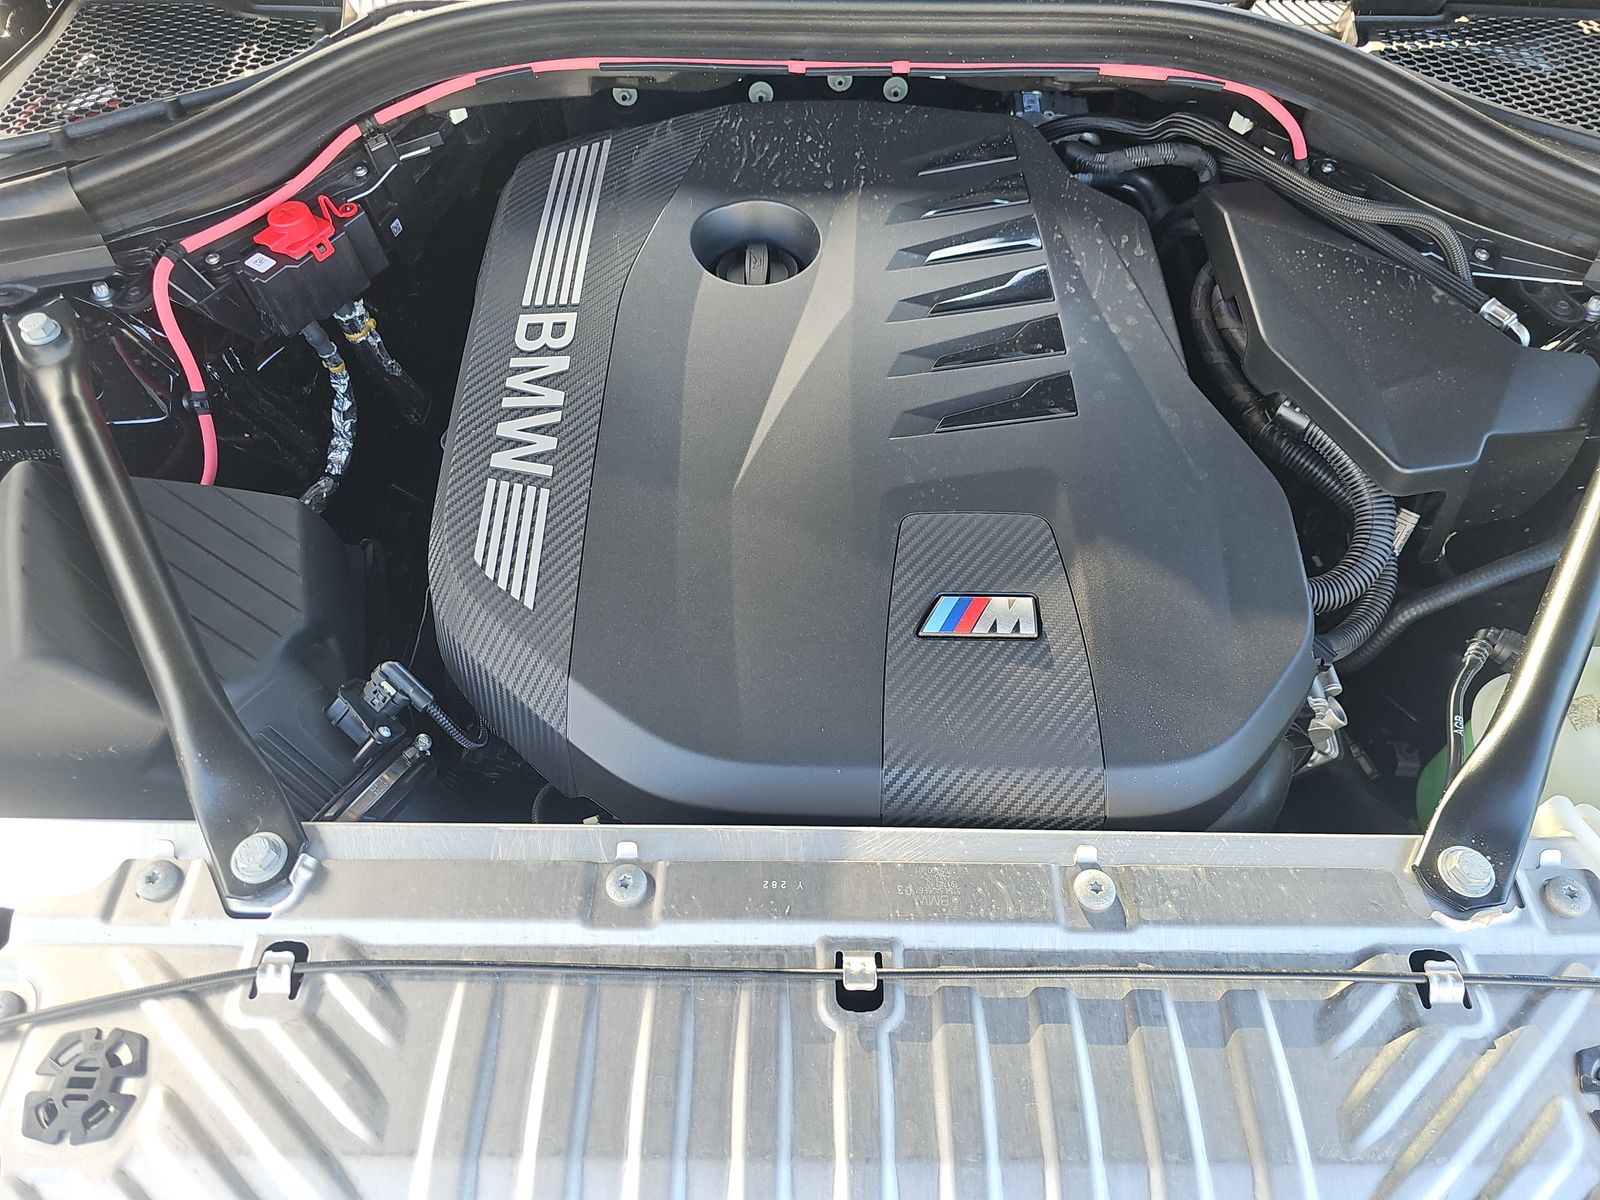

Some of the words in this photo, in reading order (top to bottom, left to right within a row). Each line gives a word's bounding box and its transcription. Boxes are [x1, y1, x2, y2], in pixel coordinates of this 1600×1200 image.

[489, 312, 578, 477] BMW
[971, 597, 1036, 633] M
[1453, 714, 1464, 737] AGB
[763, 880, 787, 889] 282
[796, 881, 804, 890] Y
[914, 894, 949, 906] BMW
